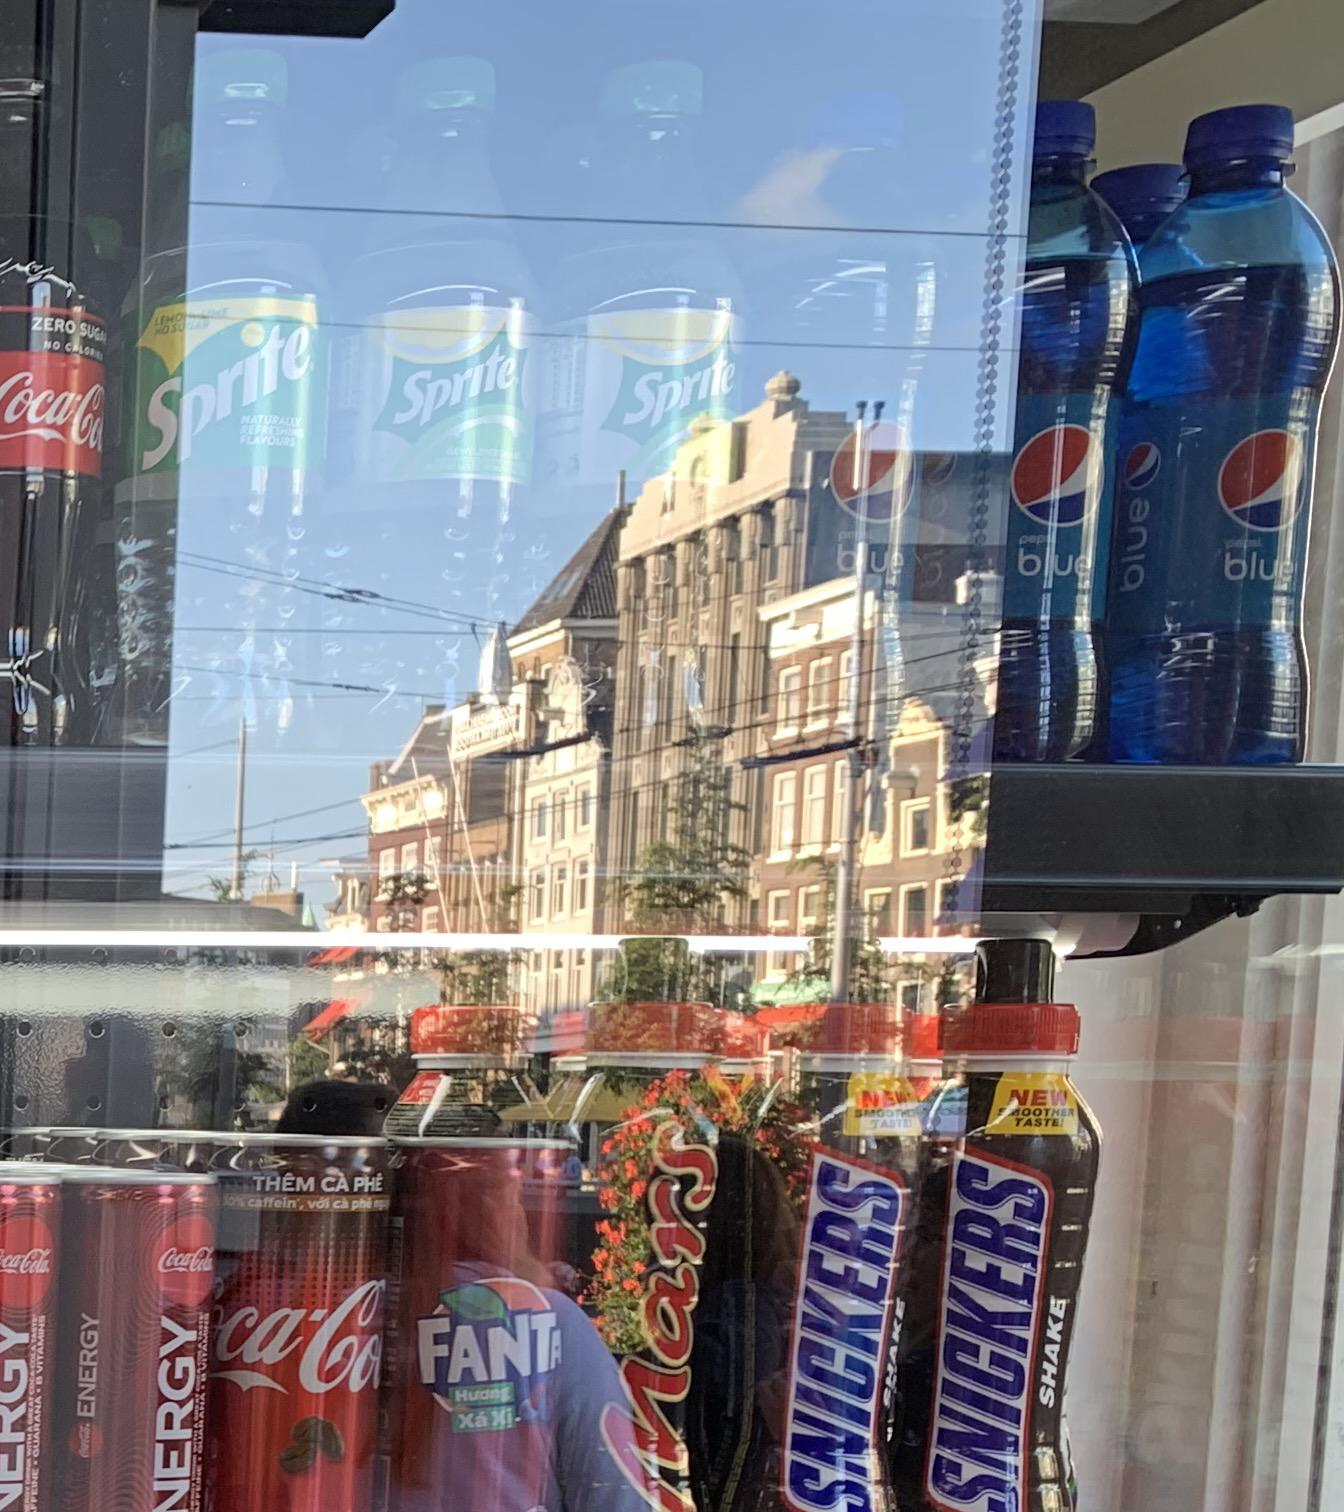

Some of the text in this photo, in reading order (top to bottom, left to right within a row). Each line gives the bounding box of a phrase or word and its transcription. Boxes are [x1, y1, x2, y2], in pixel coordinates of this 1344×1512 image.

[32, 317, 76, 335] ZERO
[141, 320, 314, 472] Sprite
[393, 349, 520, 427] Sprite
[622, 348, 736, 429] Sprite
[1017, 537, 1091, 579] blue
[1121, 496, 1150, 593] blue
[1224, 546, 1298, 582] blue
[860, 1089, 912, 1108] NEW
[1008, 1088, 1069, 1107] NEW
[77, 1312, 100, 1418] ENERGY
[416, 1309, 563, 1386] FANTA
[1039, 1298, 1067, 1410] SHAKE
